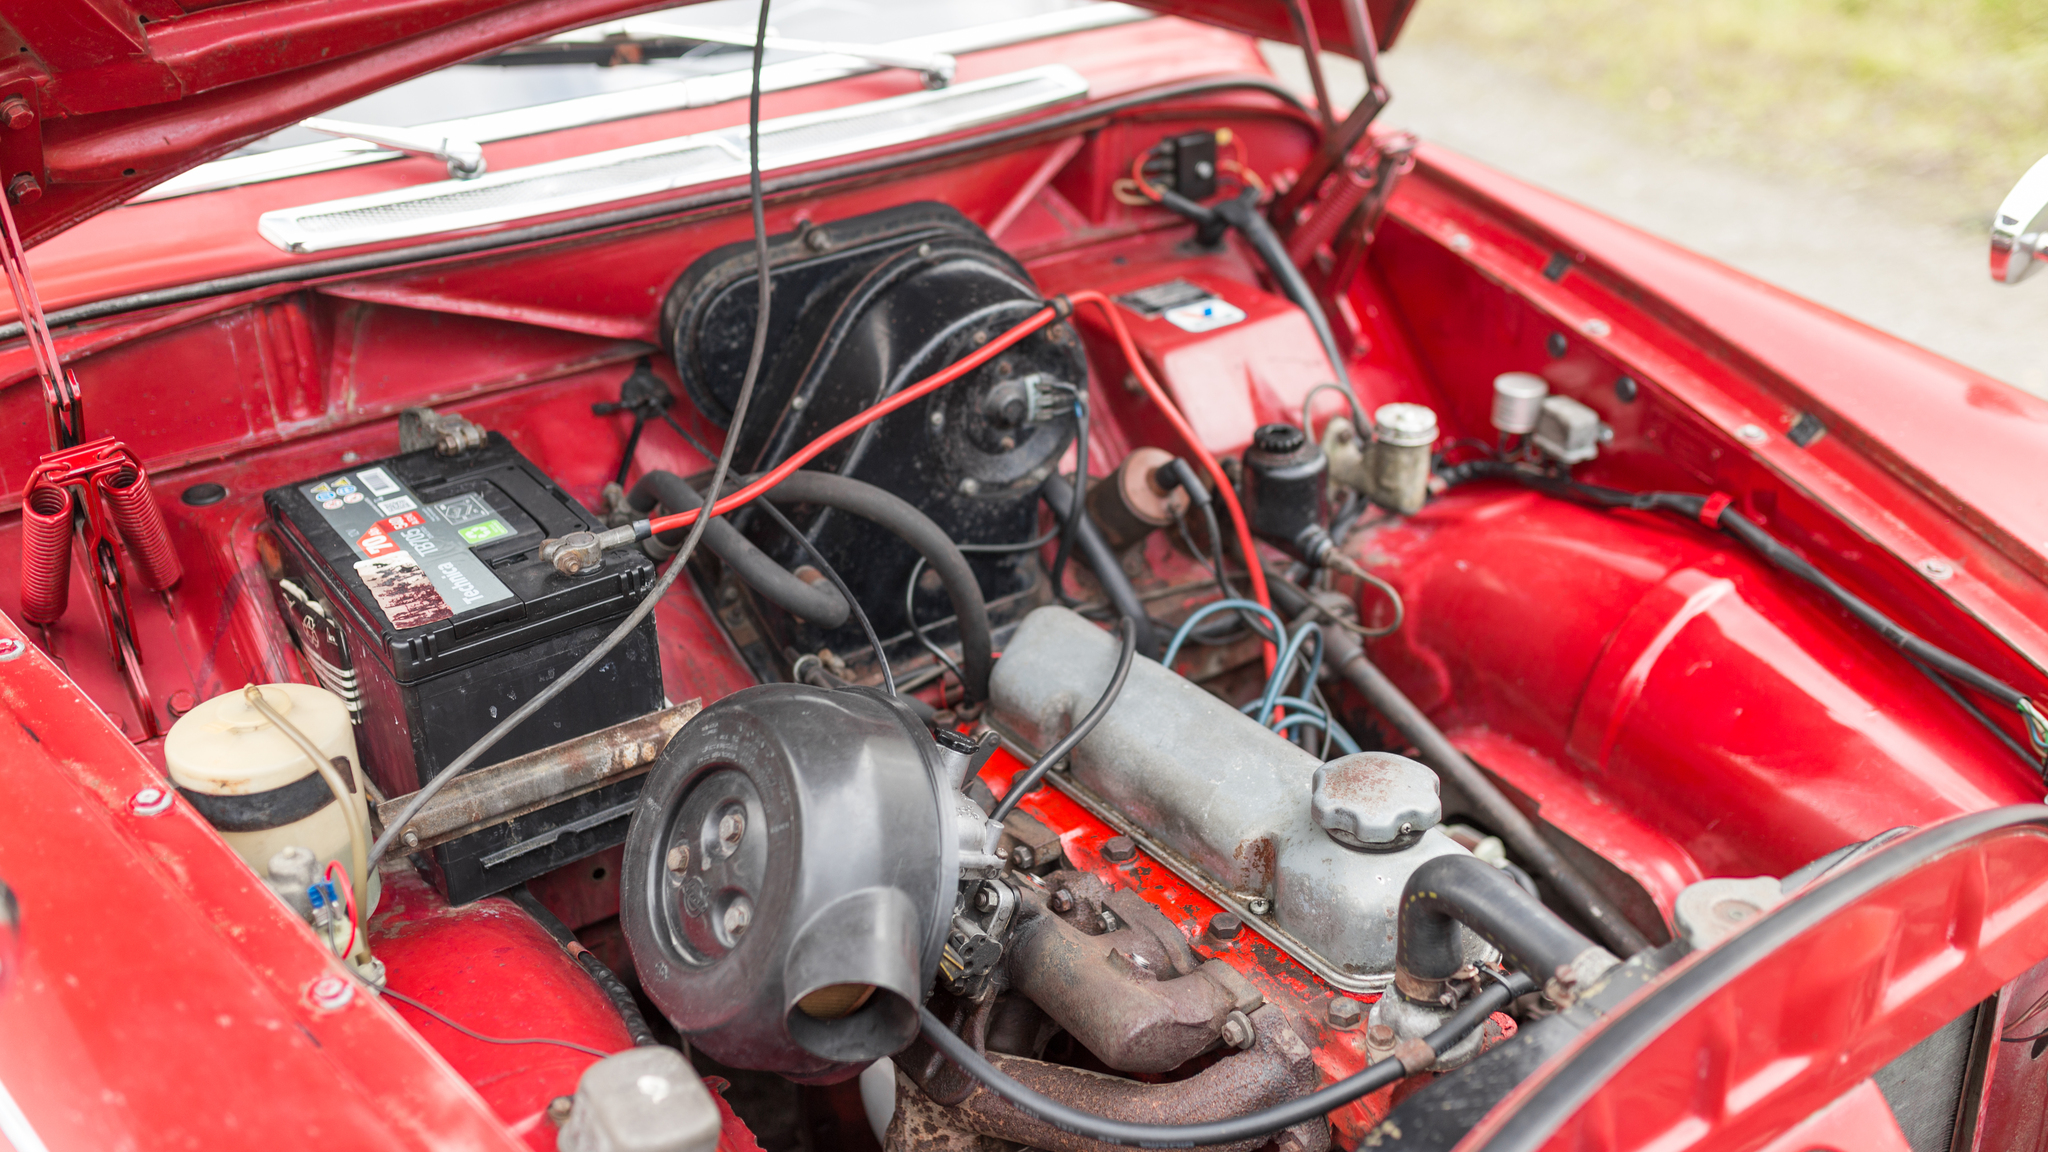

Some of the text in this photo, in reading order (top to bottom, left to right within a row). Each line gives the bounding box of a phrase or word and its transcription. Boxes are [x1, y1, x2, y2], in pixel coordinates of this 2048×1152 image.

[362, 535, 393, 555] 70
[400, 527, 439, 557] TB705
[437, 561, 484, 605] Technica
